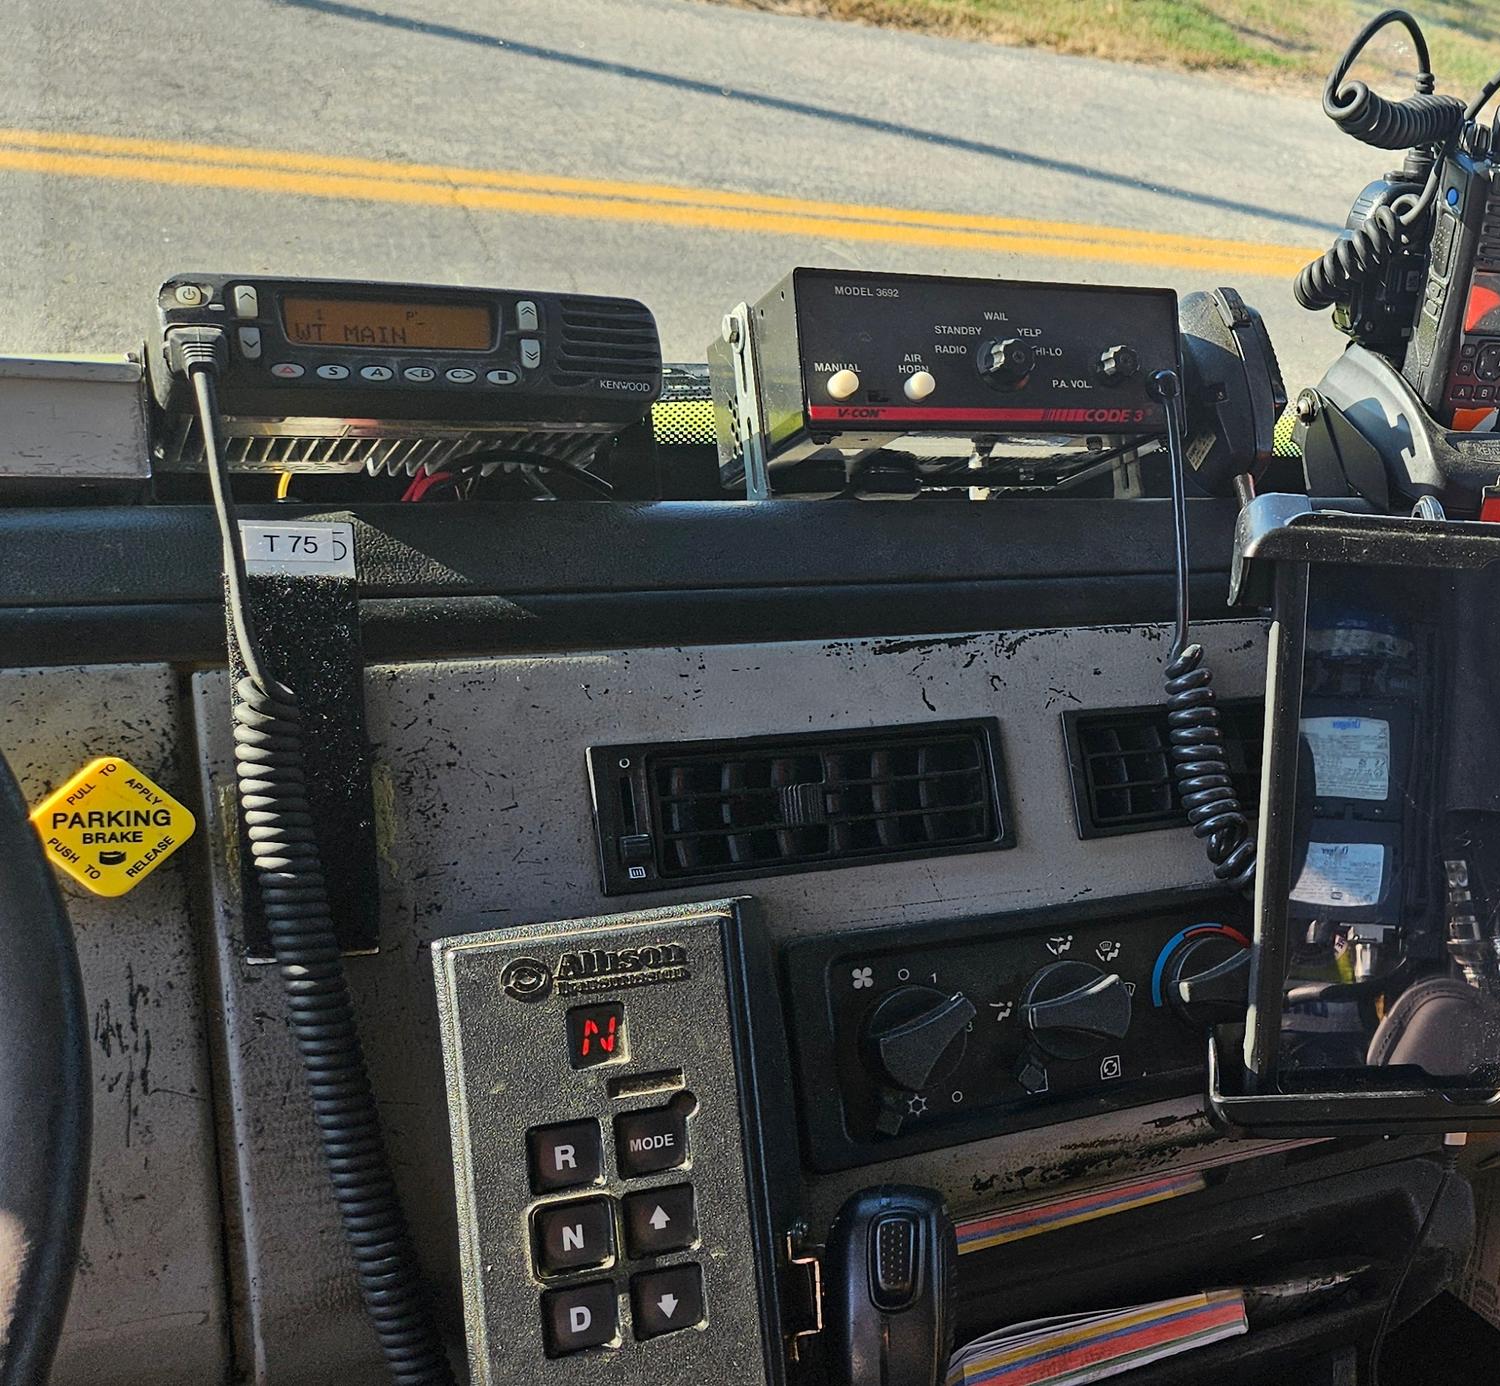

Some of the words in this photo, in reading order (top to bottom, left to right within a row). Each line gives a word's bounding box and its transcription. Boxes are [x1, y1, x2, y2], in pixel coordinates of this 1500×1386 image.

[834, 286, 874, 297] MODEL
[876, 288, 900, 298] 3692
[983, 311, 1009, 321] WAIL
[294, 323, 327, 341] WT
[343, 325, 407, 344] MAIN
[934, 325, 982, 336] STANDBY
[1017, 327, 1042, 337] YELP
[934, 345, 967, 355] RADIO
[1035, 347, 1063, 357] HI-LO
[903, 353, 922, 363] AIR
[328, 367, 338, 376] S
[370, 368, 384, 377] A
[814, 362, 862, 373] MANUAL
[898, 365, 929, 374] HORN
[600, 380, 650, 392] KENWOOD
[1052, 379, 1069, 389] P.A.
[1070, 379, 1093, 389] VOL.
[1458, 388, 1465, 397] A
[1481, 389, 1488, 398] B
[1084, 408, 1131, 422] CODE
[263, 534, 280, 553] T
[288, 535, 318, 554] 75
[66, 782, 97, 806] PULL
[99, 763, 117, 778] TO
[124, 777, 163, 806] APPLY
[52, 809, 172, 830] PARKING
[82, 831, 144, 844] BRAKE
[47, 837, 81, 864] PUSH
[84, 864, 101, 880] TO
[125, 835, 176, 878] RELEASE
[552, 942, 688, 979] Allison
[582, 1015, 616, 1057] N
[629, 1132, 675, 1153] MODE
[554, 1143, 577, 1171] R
[562, 1223, 584, 1251] N
[569, 1307, 592, 1334] D
